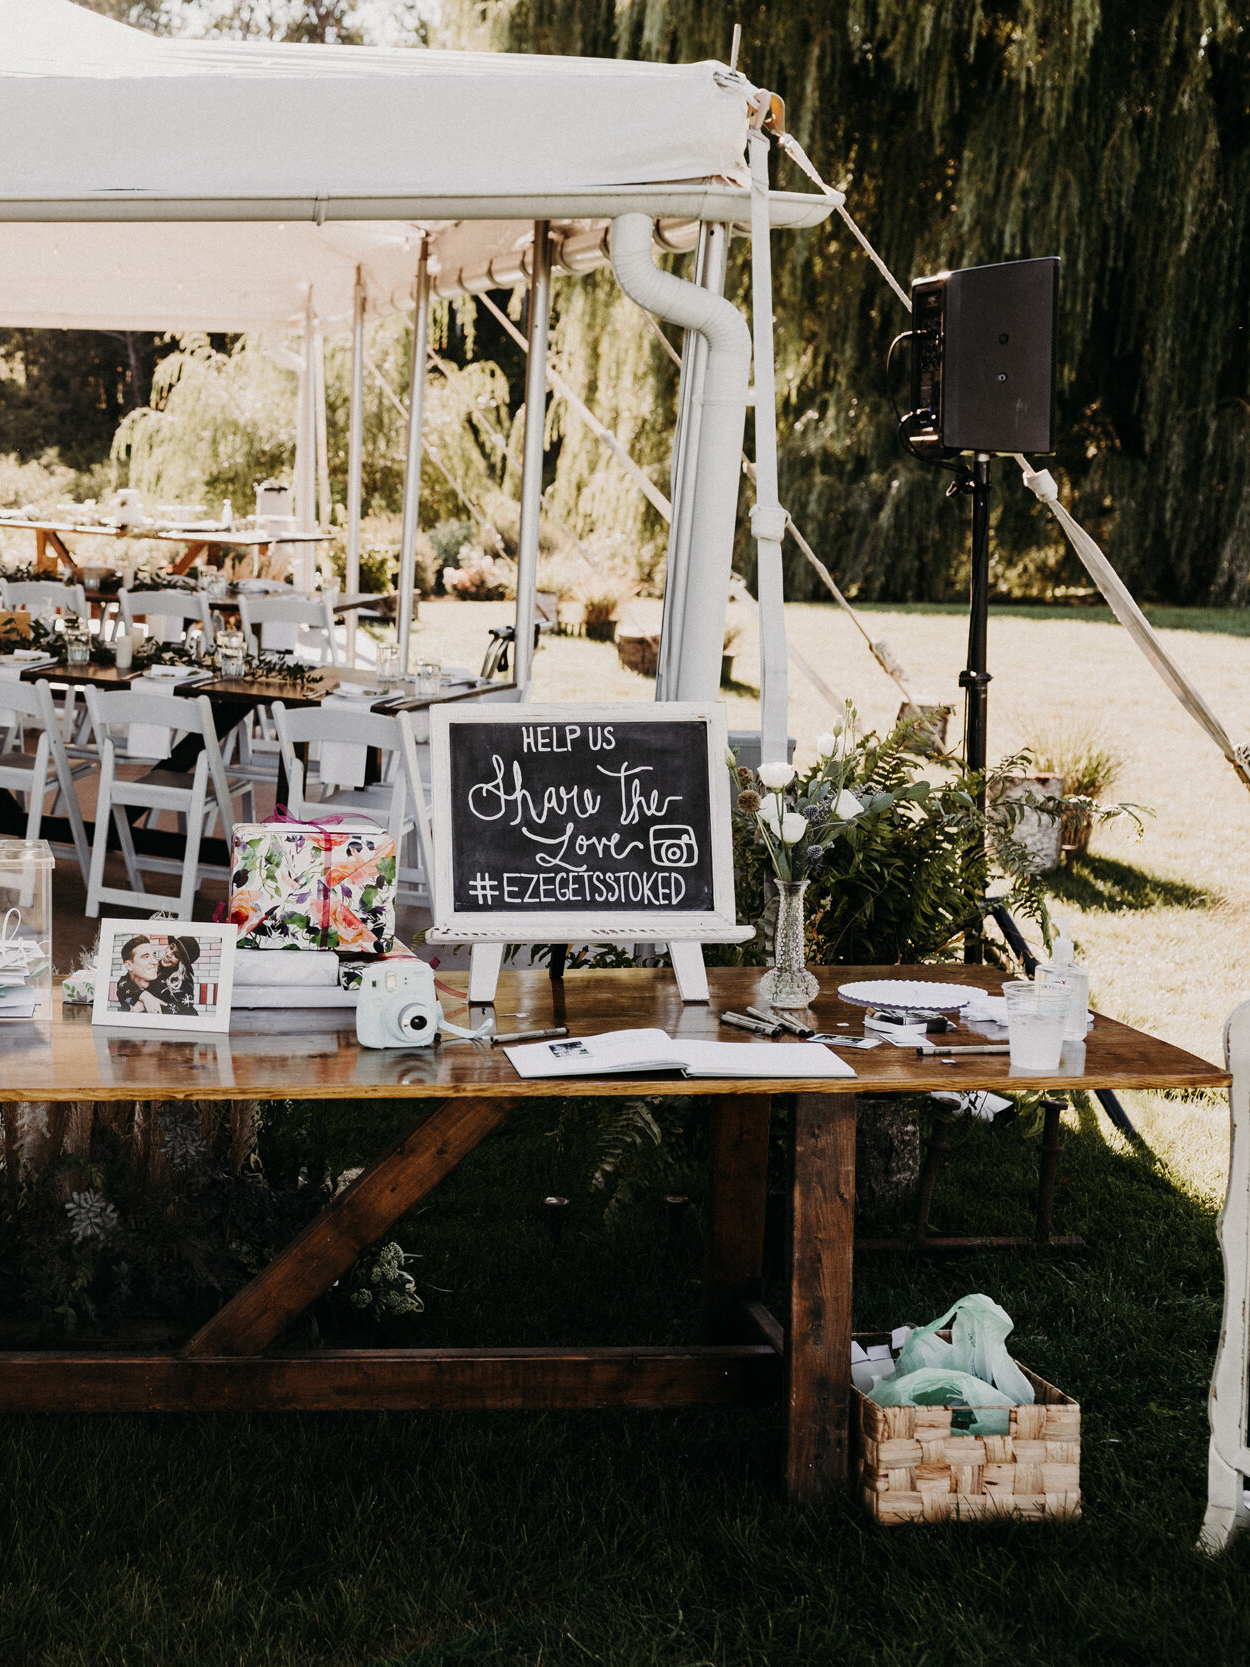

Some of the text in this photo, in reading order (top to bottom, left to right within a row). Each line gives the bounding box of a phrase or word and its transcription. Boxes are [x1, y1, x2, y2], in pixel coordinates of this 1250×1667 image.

[521, 725, 616, 753] HELP US
[468, 754, 684, 826] Share The
[521, 821, 645, 872] Love
[468, 871, 687, 906] #EZEGETSSTOKED
